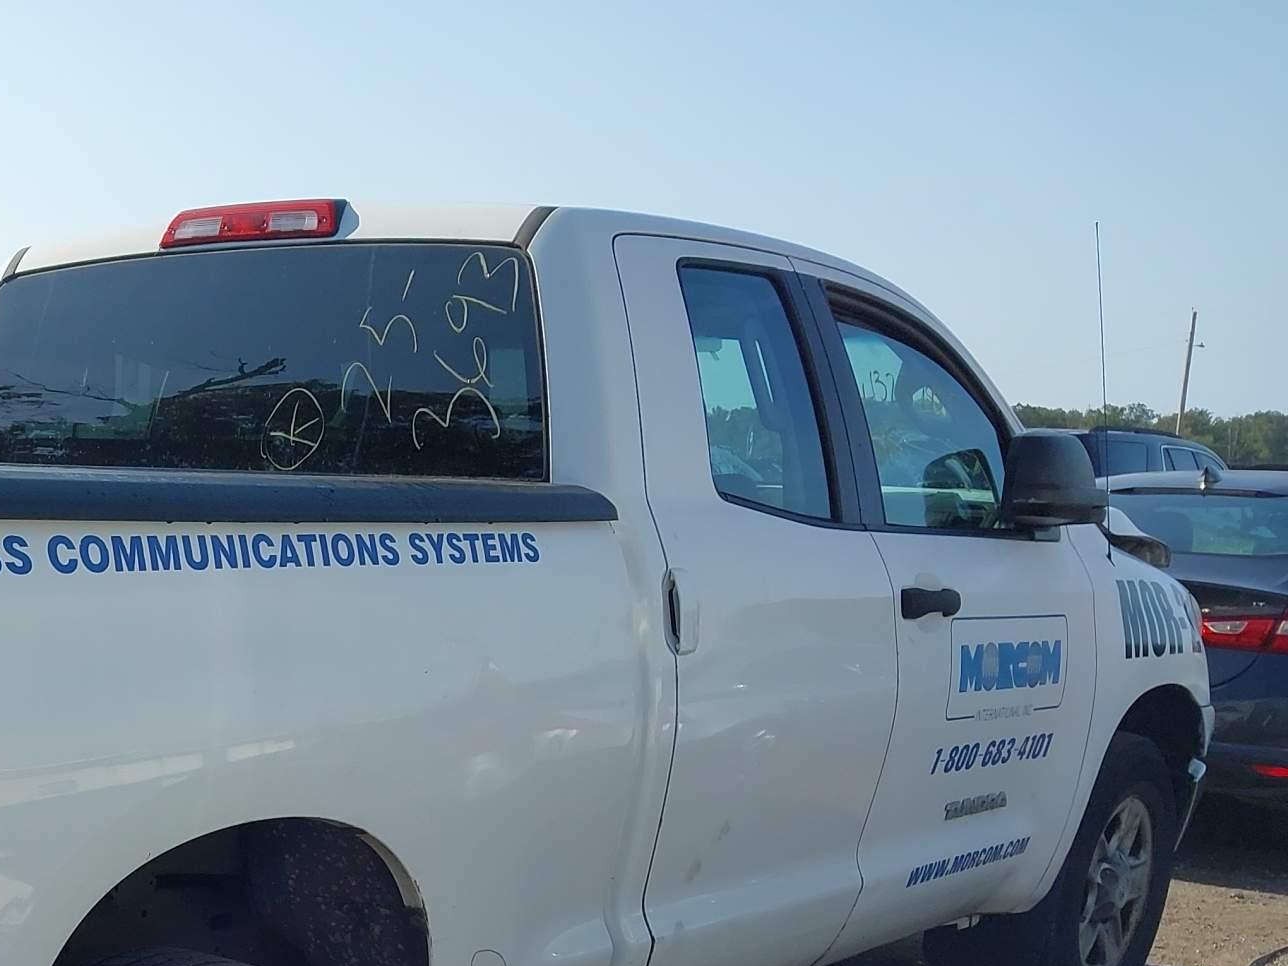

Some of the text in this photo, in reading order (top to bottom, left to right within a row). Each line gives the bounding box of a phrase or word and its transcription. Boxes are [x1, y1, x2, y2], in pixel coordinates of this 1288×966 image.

[47, 532, 400, 574] COMMUNICATIONS
[409, 531, 541, 565] SYSTEMS
[959, 639, 1062, 692] MORCOM
[930, 732, 1054, 775] 1-800-683-4101
[905, 836, 1031, 889] WWW.MORCOM.COM
